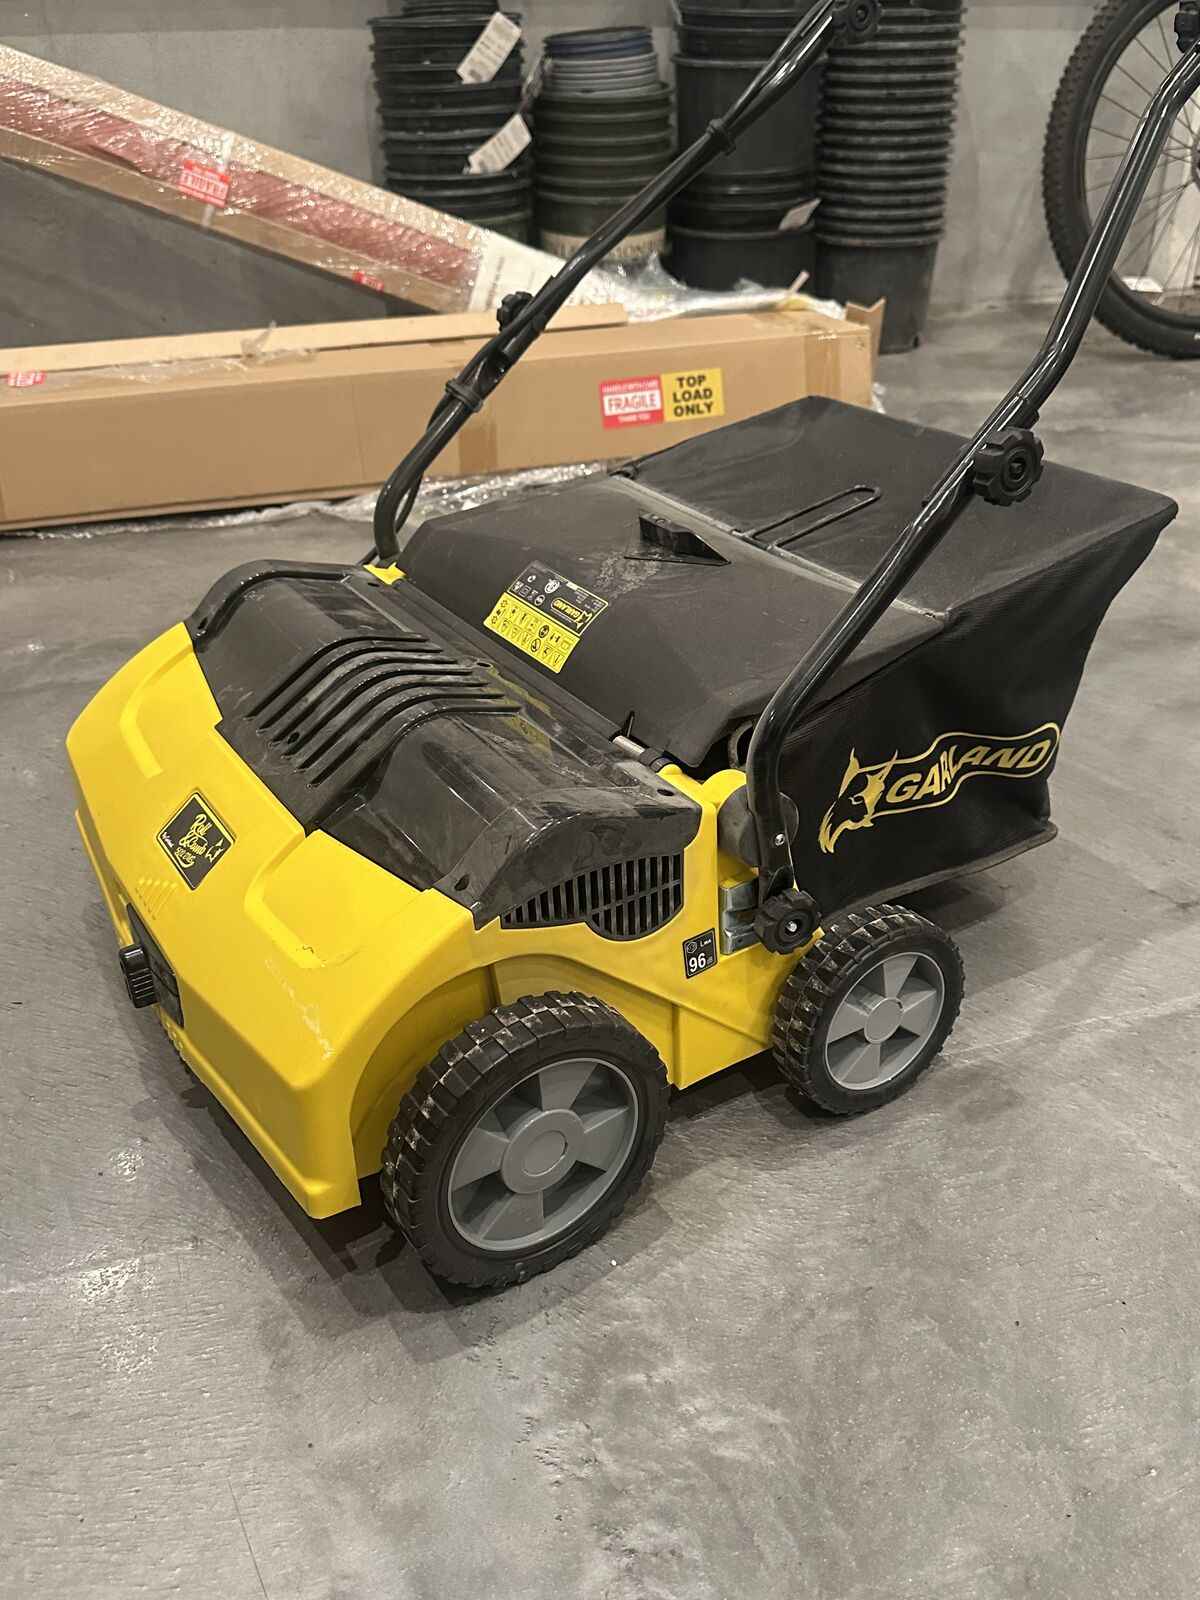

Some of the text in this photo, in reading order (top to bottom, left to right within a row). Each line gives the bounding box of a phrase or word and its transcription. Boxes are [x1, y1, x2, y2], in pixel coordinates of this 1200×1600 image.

[676, 375, 706, 388] TOP
[607, 393, 657, 412] FRAGILE
[672, 388, 713, 403] LOAD
[673, 402, 714, 417] ONLY
[553, 600, 581, 619] GARLAND
[886, 739, 1051, 803] GARLAND
[689, 953, 706, 972] 96
